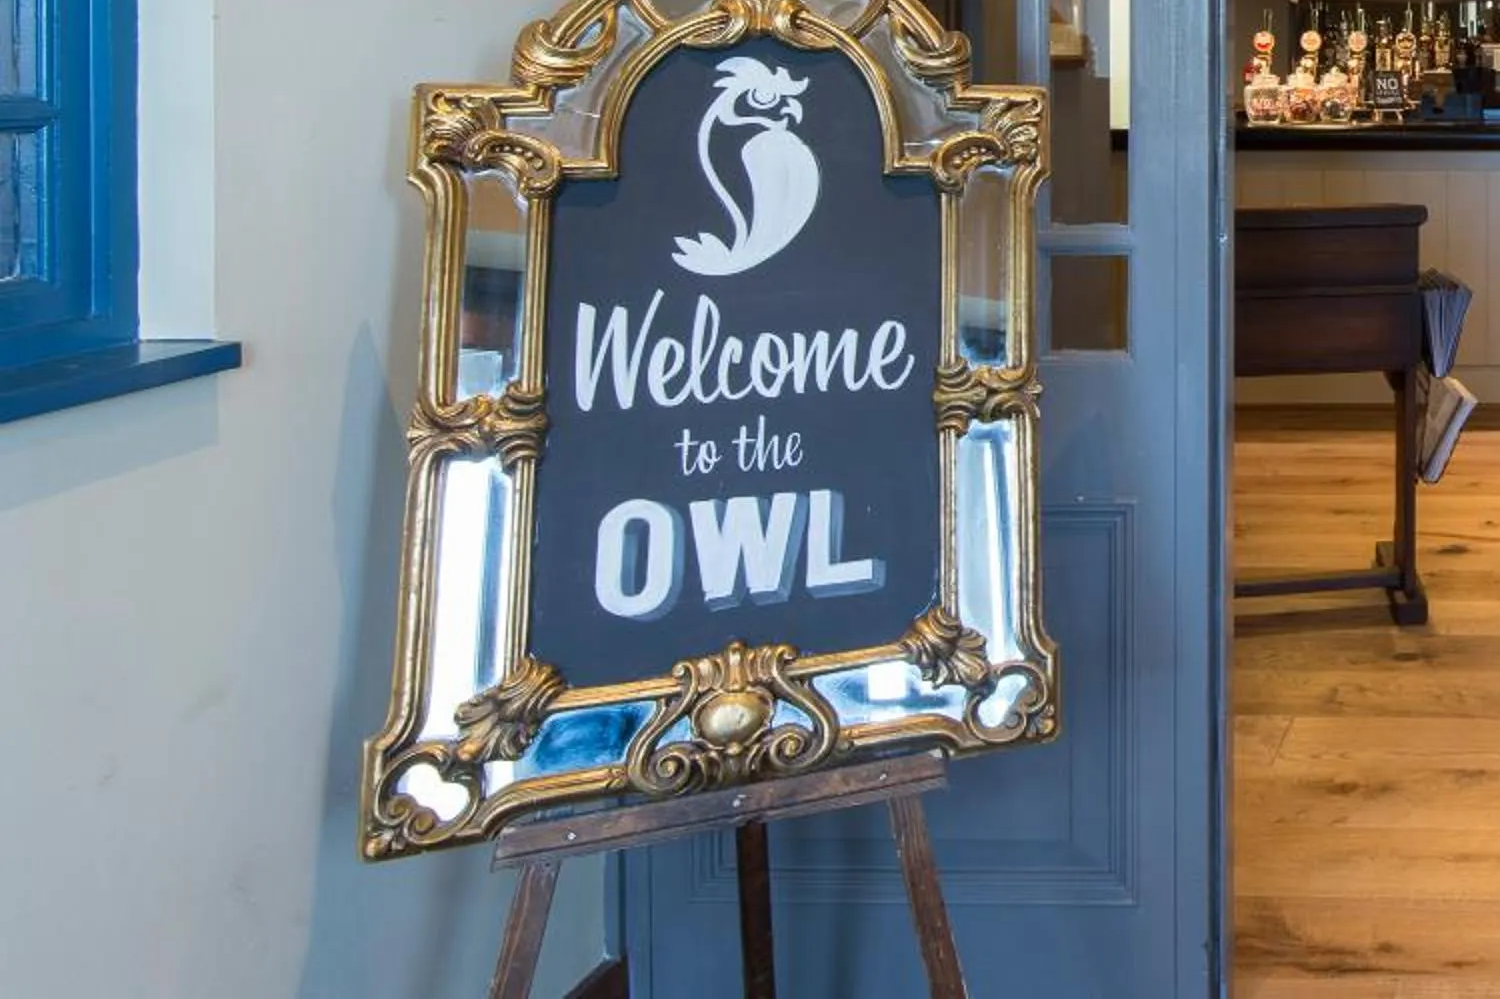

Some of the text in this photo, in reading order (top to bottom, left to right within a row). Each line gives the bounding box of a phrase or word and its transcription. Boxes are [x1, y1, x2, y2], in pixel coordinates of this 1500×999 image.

[1375, 78, 1399, 90] NO
[575, 288, 915, 412] Welcome
[674, 414, 803, 476] to the
[595, 489, 885, 621] OWL
